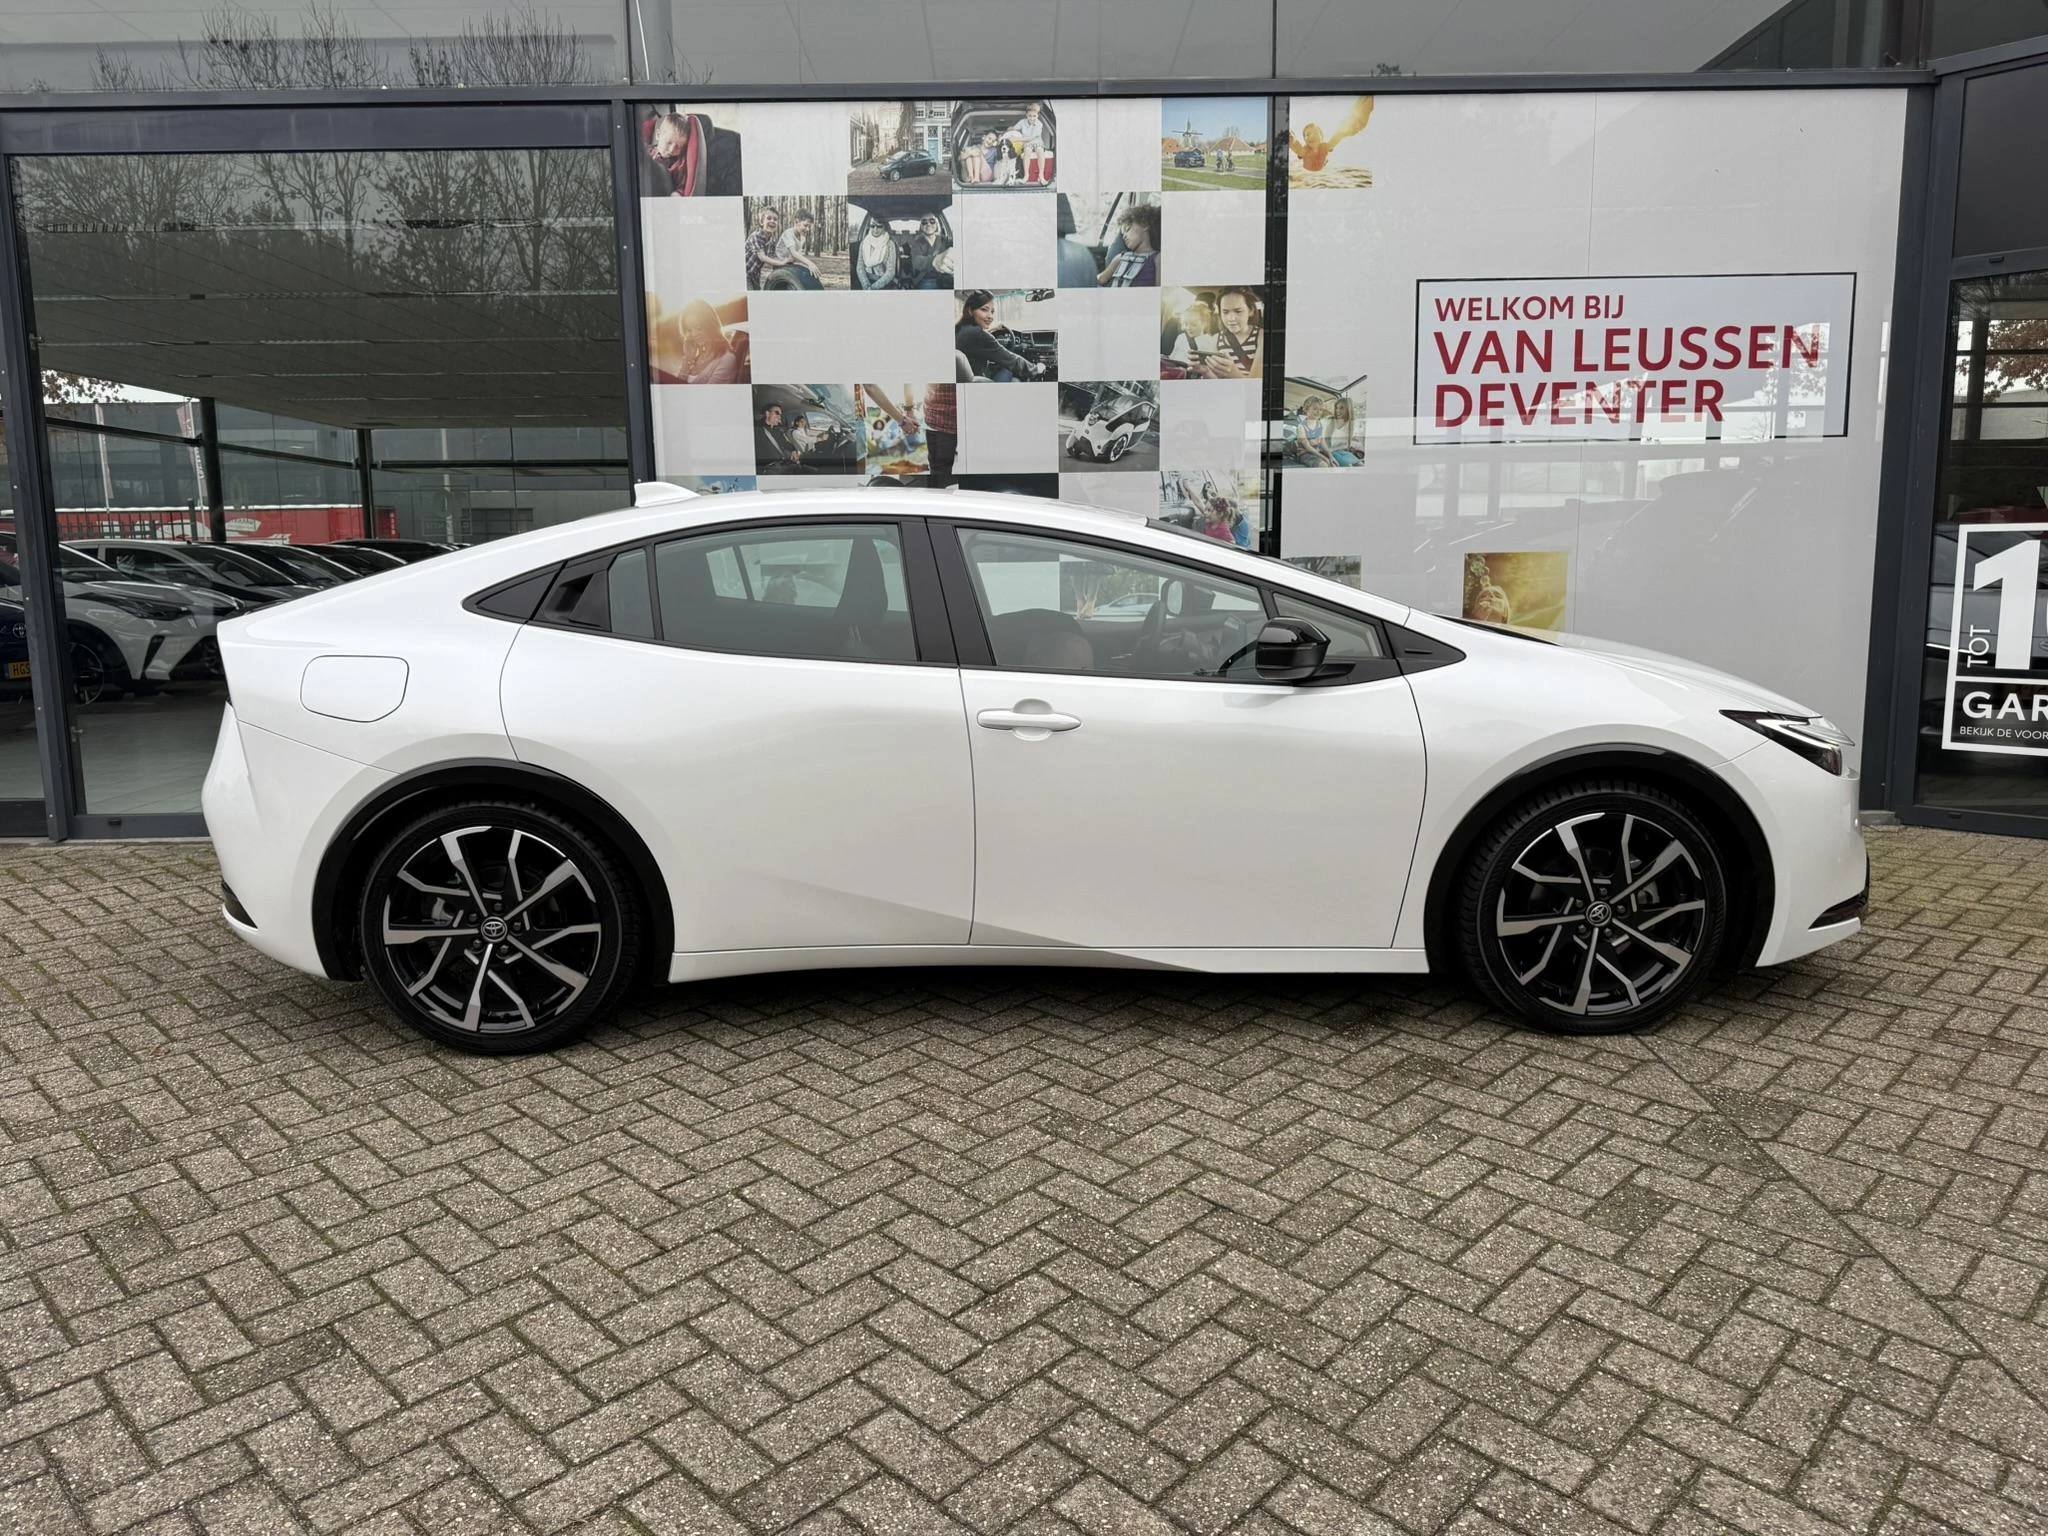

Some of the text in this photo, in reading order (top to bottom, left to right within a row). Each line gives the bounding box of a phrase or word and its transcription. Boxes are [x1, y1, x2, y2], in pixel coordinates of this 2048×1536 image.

[1434, 294, 1625, 322] WELKOM BIJ
[1433, 324, 1820, 375] VAN LEUSSEN
[1434, 379, 1725, 428] DEVENTER
[1973, 539, 2048, 671] 1
[1966, 624, 1991, 668] TOT
[1962, 690, 2048, 722] GAR
[1959, 726, 2048, 740] BEKIJK DE VOOR
